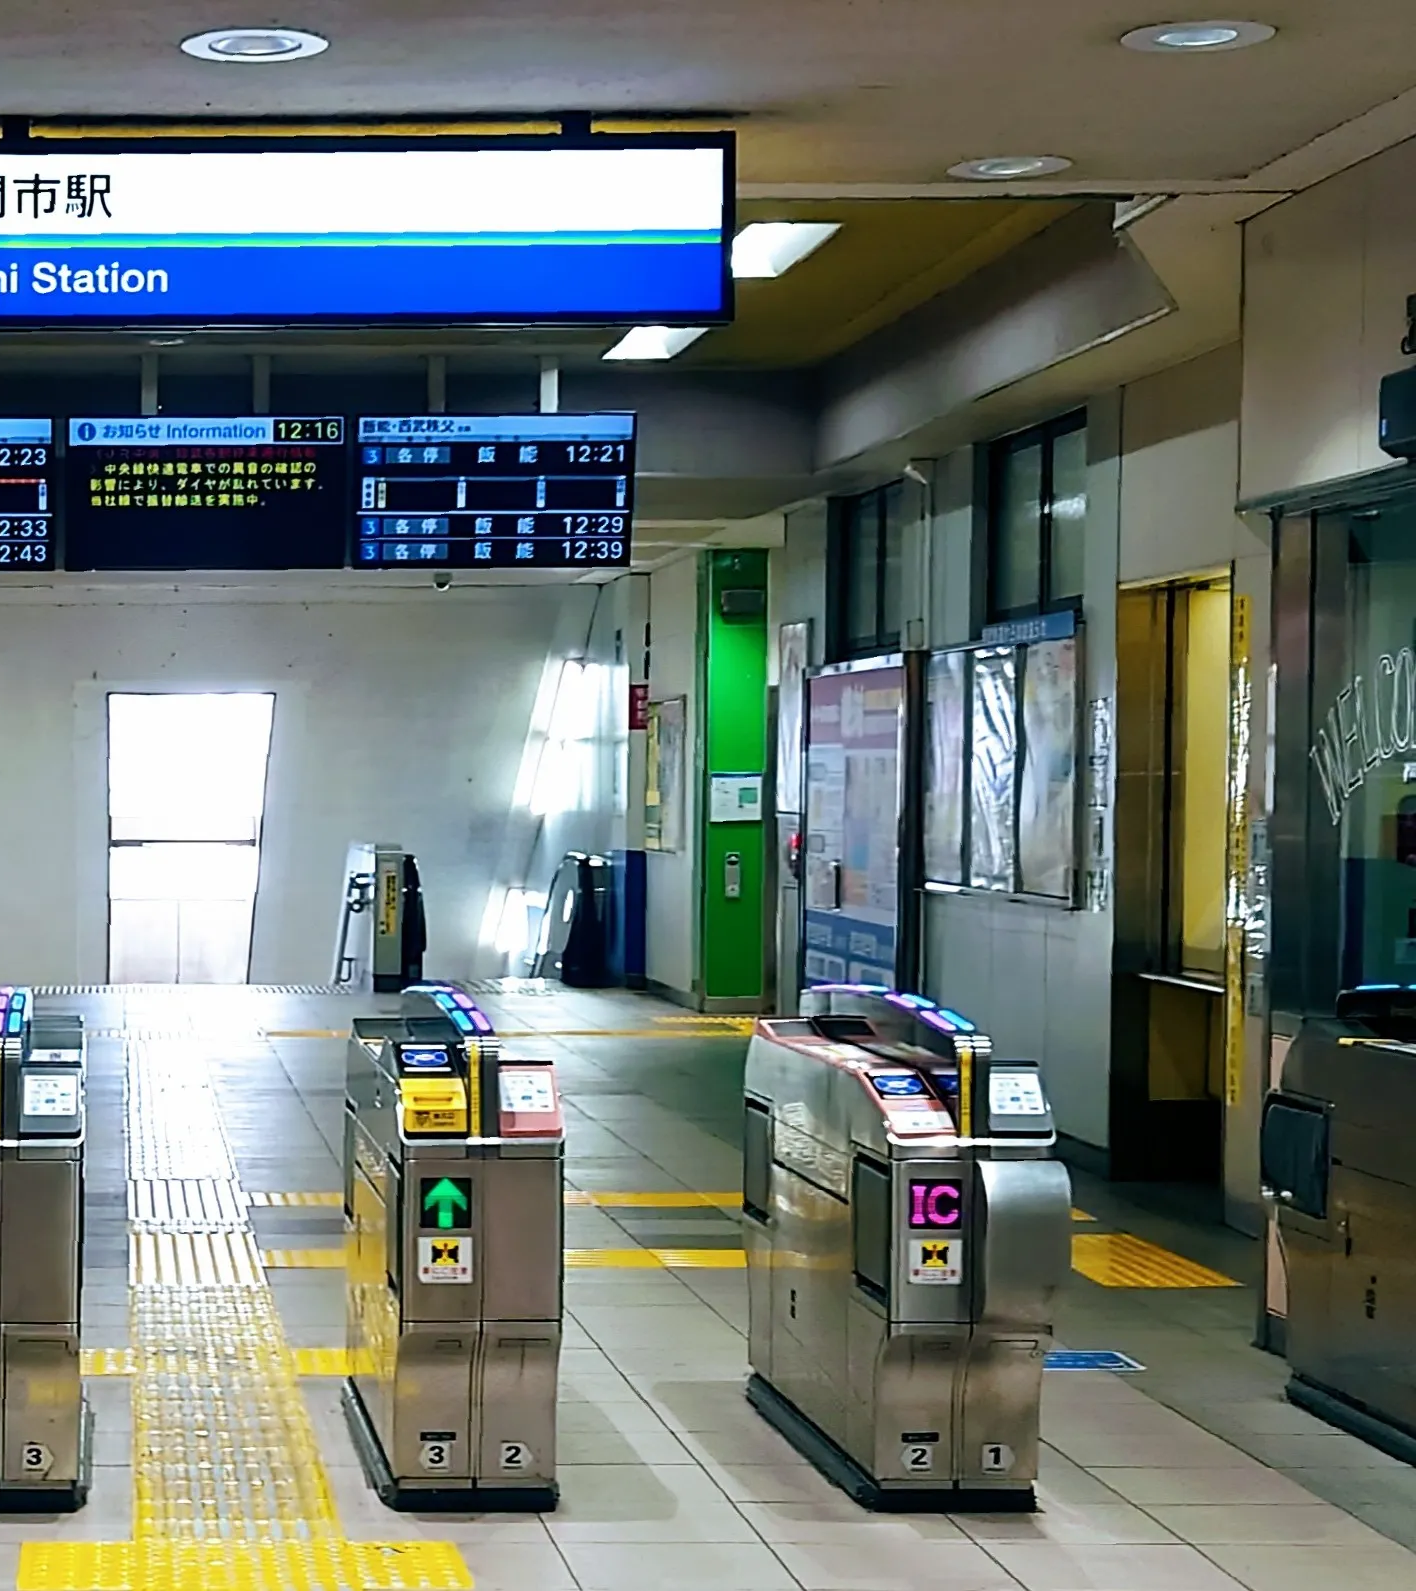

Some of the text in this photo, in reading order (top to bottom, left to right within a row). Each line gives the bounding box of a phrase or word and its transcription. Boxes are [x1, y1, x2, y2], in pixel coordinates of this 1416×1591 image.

[32, 262, 168, 294] Station
[102, 422, 339, 440] お知らせ Information 12:16
[366, 445, 625, 464] 3 各停 飯能 12:21
[365, 516, 624, 535] 3 各停 飯能 12:29
[365, 541, 623, 560] 3 各停 飯能 12:39
[1309, 647, 1416, 826] WELCO
[912, 1185, 960, 1225] IC
[26, 1448, 42, 1465] 3
[428, 1445, 444, 1464] 3
[505, 1445, 521, 1464] 2
[911, 1447, 928, 1465] 2
[988, 1446, 1001, 1465] 1
